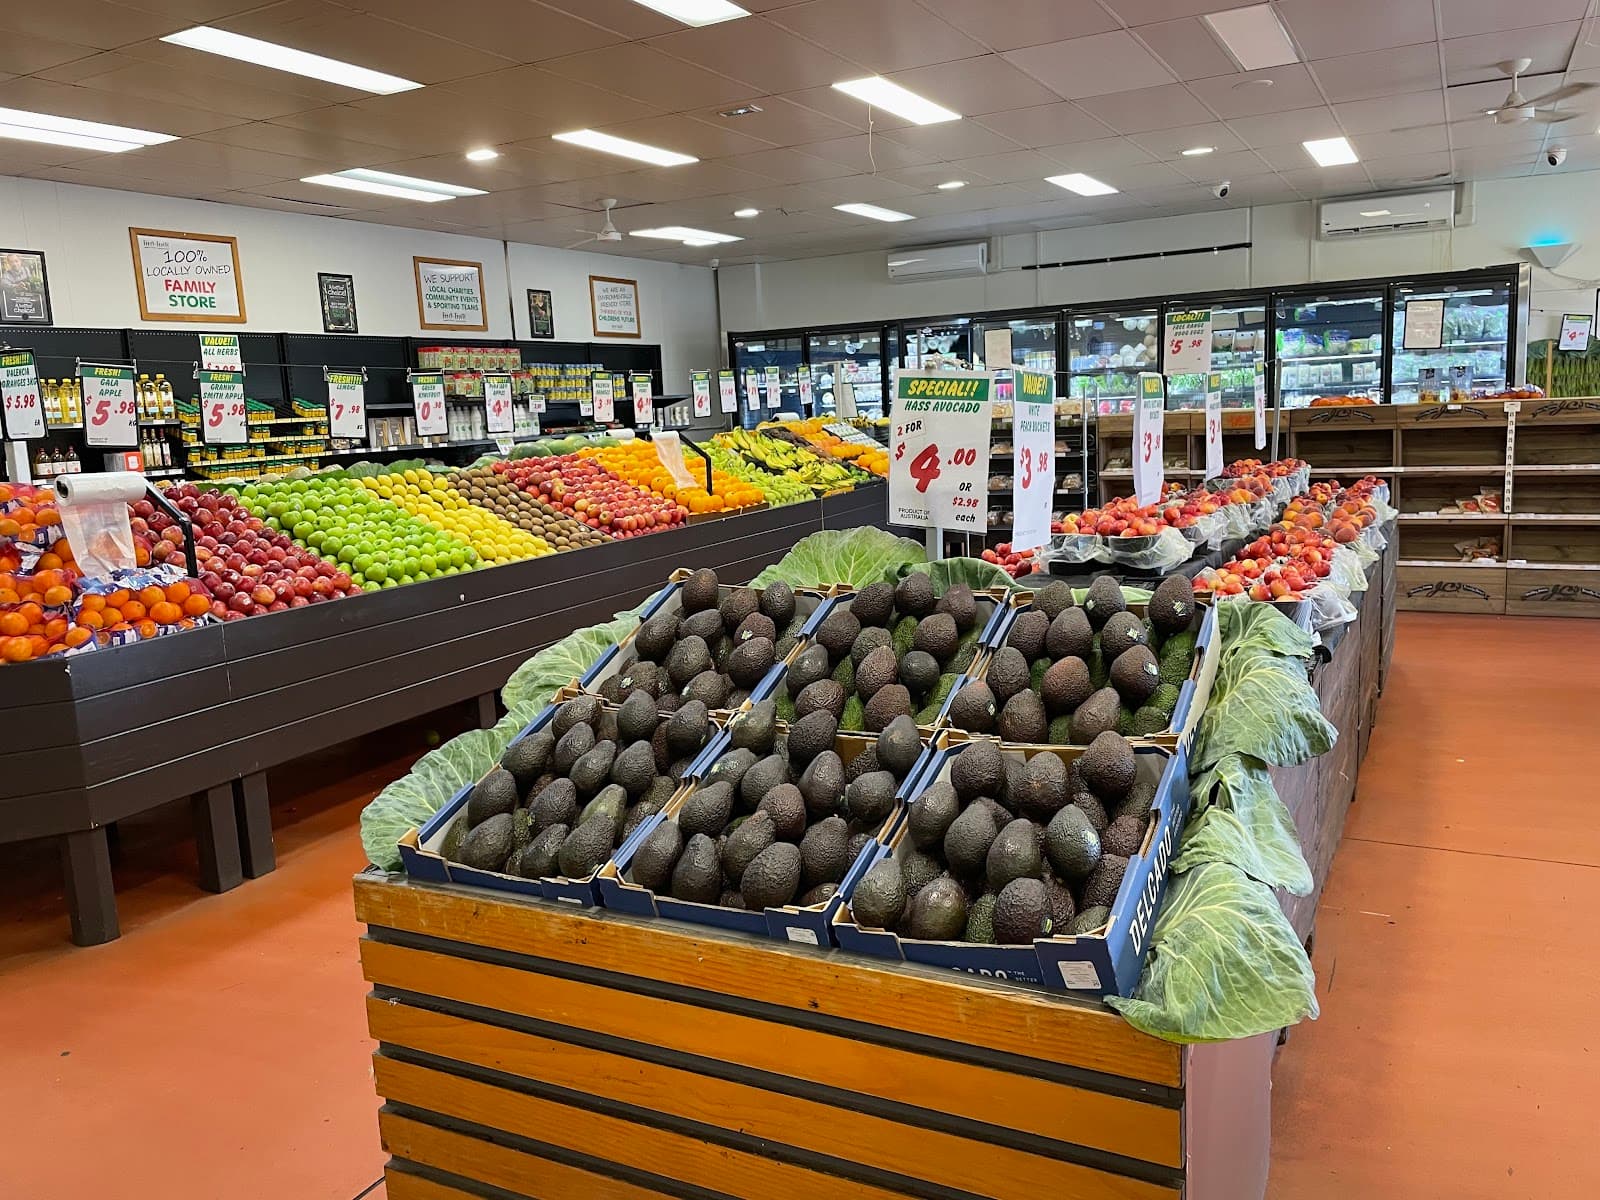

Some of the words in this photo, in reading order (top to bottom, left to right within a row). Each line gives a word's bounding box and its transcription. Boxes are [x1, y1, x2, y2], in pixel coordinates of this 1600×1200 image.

[163, 249, 207, 263] 100%
[146, 266, 190, 276] LOCALLY
[195, 264, 231, 275] OWNED
[424, 274, 437, 284] WE
[439, 273, 474, 283] SUPPORT
[164, 279, 216, 293] FAMILY
[429, 285, 447, 293] LOCAL
[447, 286, 474, 295] CHARITIES
[168, 294, 217, 309] STORE
[425, 293, 459, 302] COMMUNITY
[433, 302, 460, 310] SPORTING
[460, 303, 479, 311] TEAMS
[204, 336, 234, 346] VALUE!!
[203, 348, 217, 356] ALL
[216, 348, 239, 356] HERBS
[6, 367, 30, 377] VALENCIA
[94, 367, 122, 377] FRESH!
[100, 378, 119, 387] GALA
[209, 373, 233, 382] FRESH!
[2, 378, 26, 388] ORANGES
[210, 383, 236, 391] GRANNY
[907, 379, 979, 397] SPECIAL!!
[99, 389, 122, 397] APPLE
[203, 392, 224, 400] SMITH
[224, 392, 244, 400] APPLE
[904, 400, 931, 411] HASS
[933, 401, 980, 413] AVOCADO
[897, 425, 903, 436] 2
[905, 420, 922, 435] FOR
[959, 482, 972, 492] OR
[952, 497, 979, 508] $2.98
[898, 507, 923, 515] PRODUCT
[900, 513, 929, 521] AUSTRALIA
[955, 513, 976, 523] each
[1129, 825, 1172, 956] DELCADO
